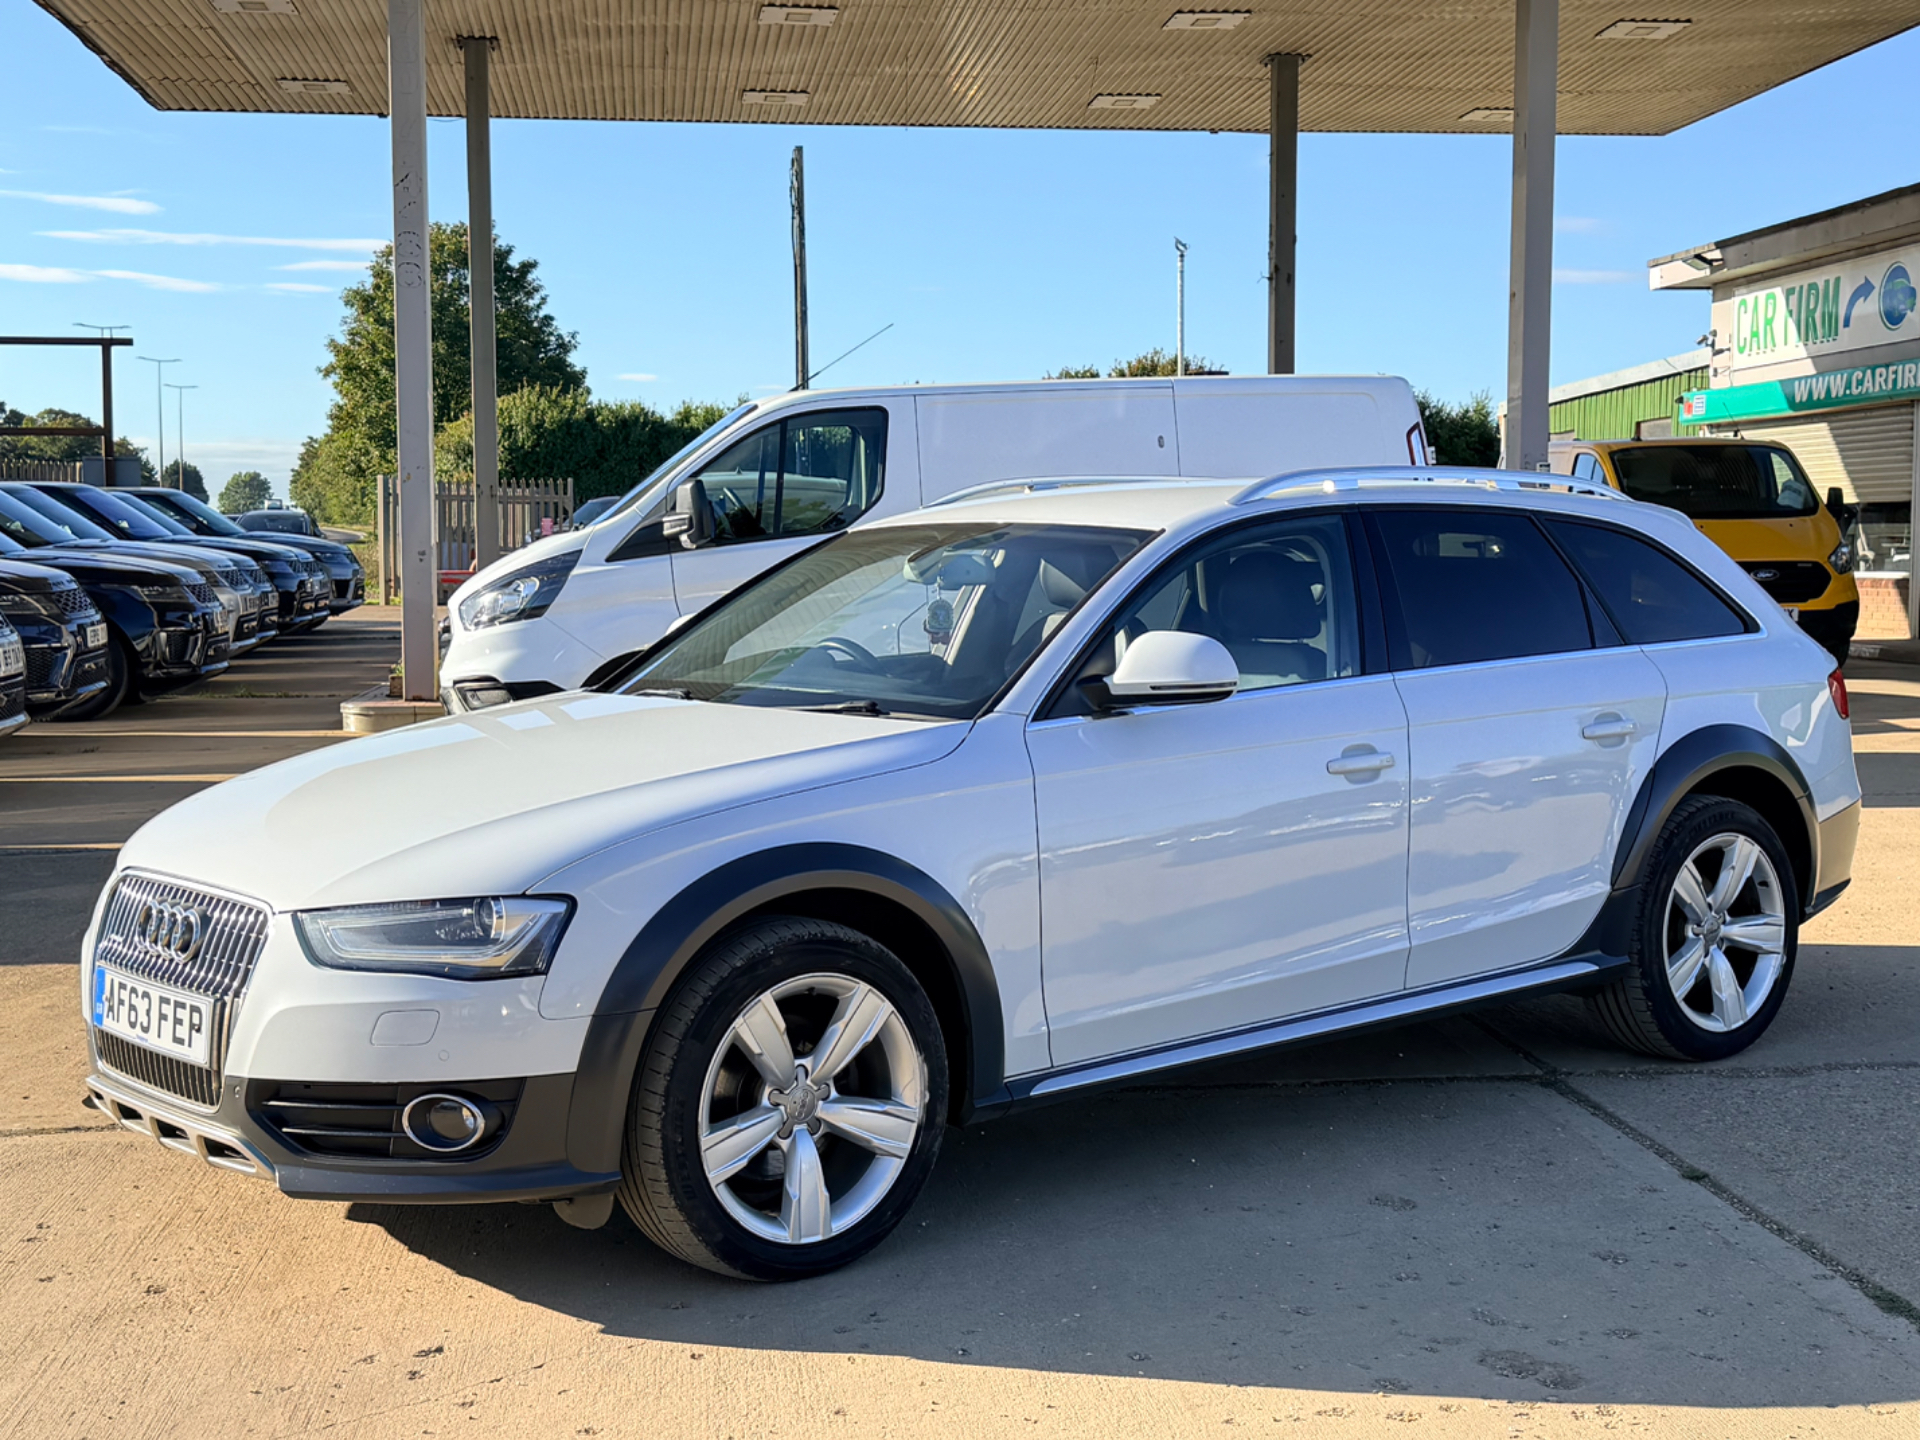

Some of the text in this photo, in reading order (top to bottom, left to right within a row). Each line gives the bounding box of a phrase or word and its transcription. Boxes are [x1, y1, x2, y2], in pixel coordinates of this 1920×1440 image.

[1737, 276, 1841, 354] CAR FIRM
[1794, 362, 1920, 403] WWW.CARFIR
[105, 978, 203, 1048] AF63 FEP
